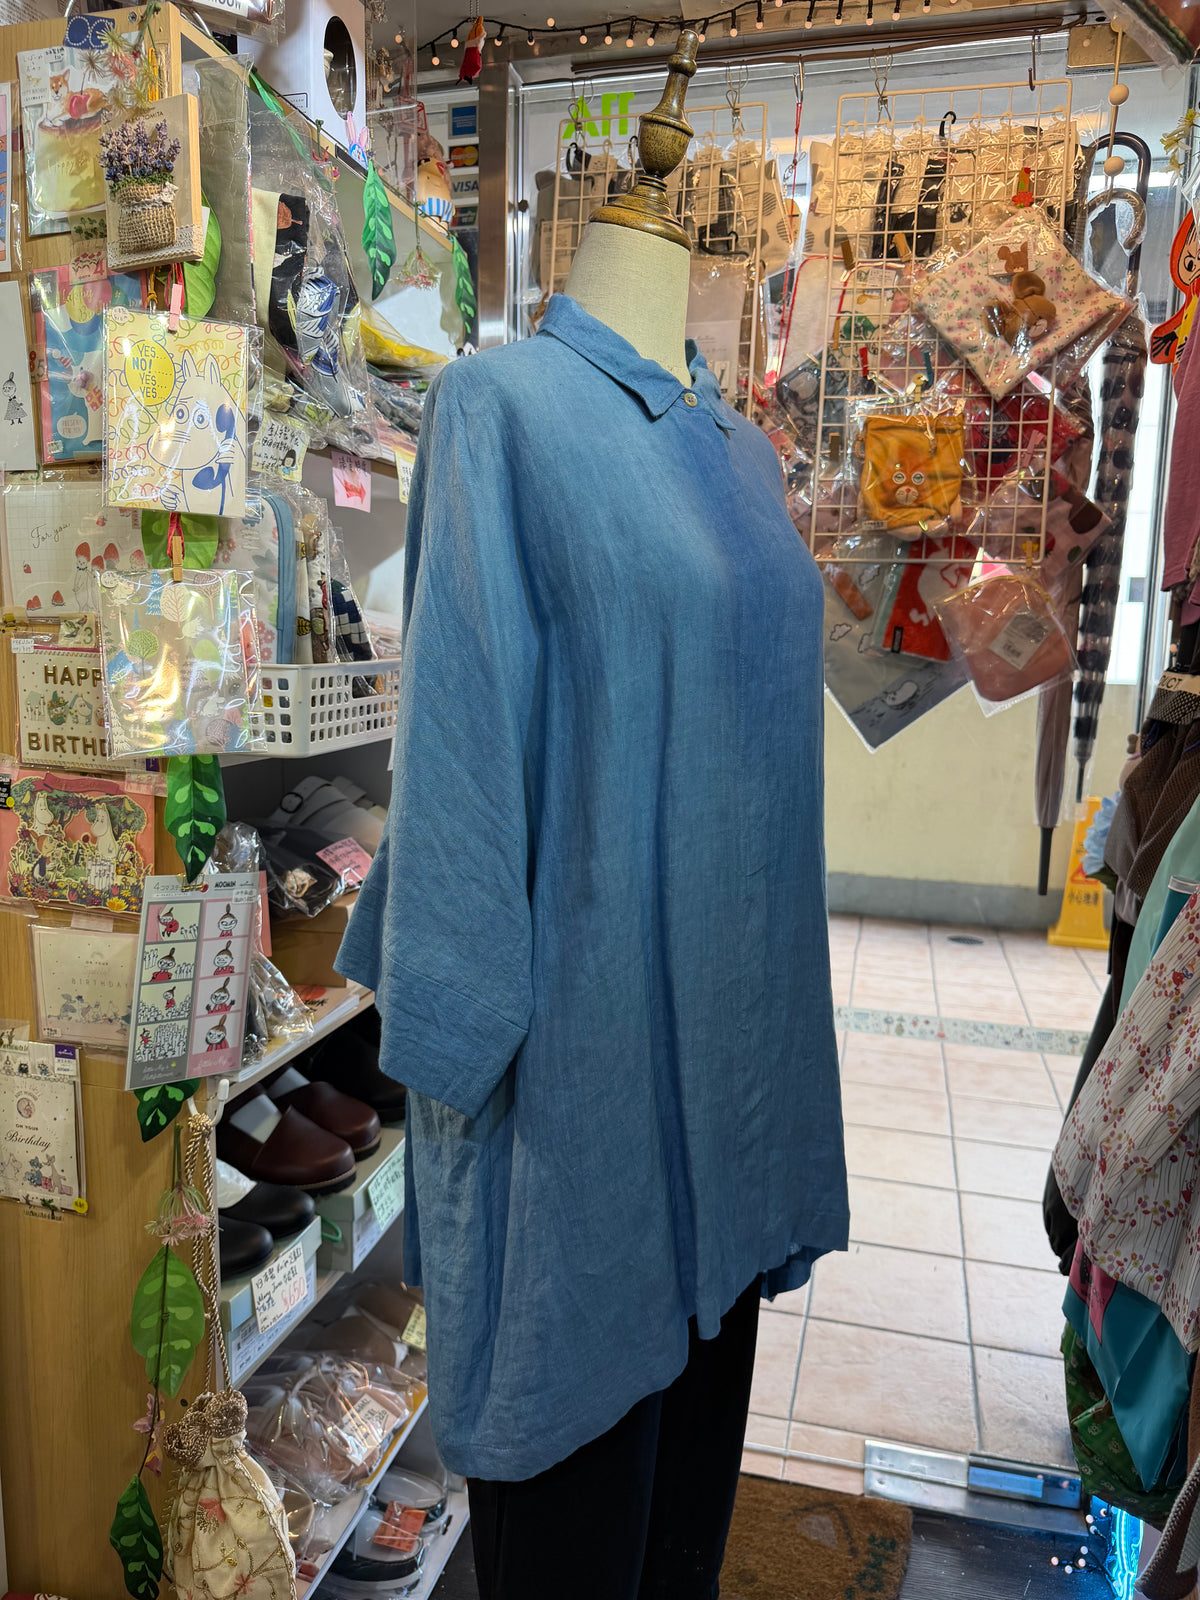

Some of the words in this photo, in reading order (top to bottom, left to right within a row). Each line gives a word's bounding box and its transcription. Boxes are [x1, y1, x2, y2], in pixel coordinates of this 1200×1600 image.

[452, 180, 479, 193] VISA
[92, 258, 105, 276] 4
[83, 626, 94, 645] 3
[4, 1129, 51, 1153] Birthday
